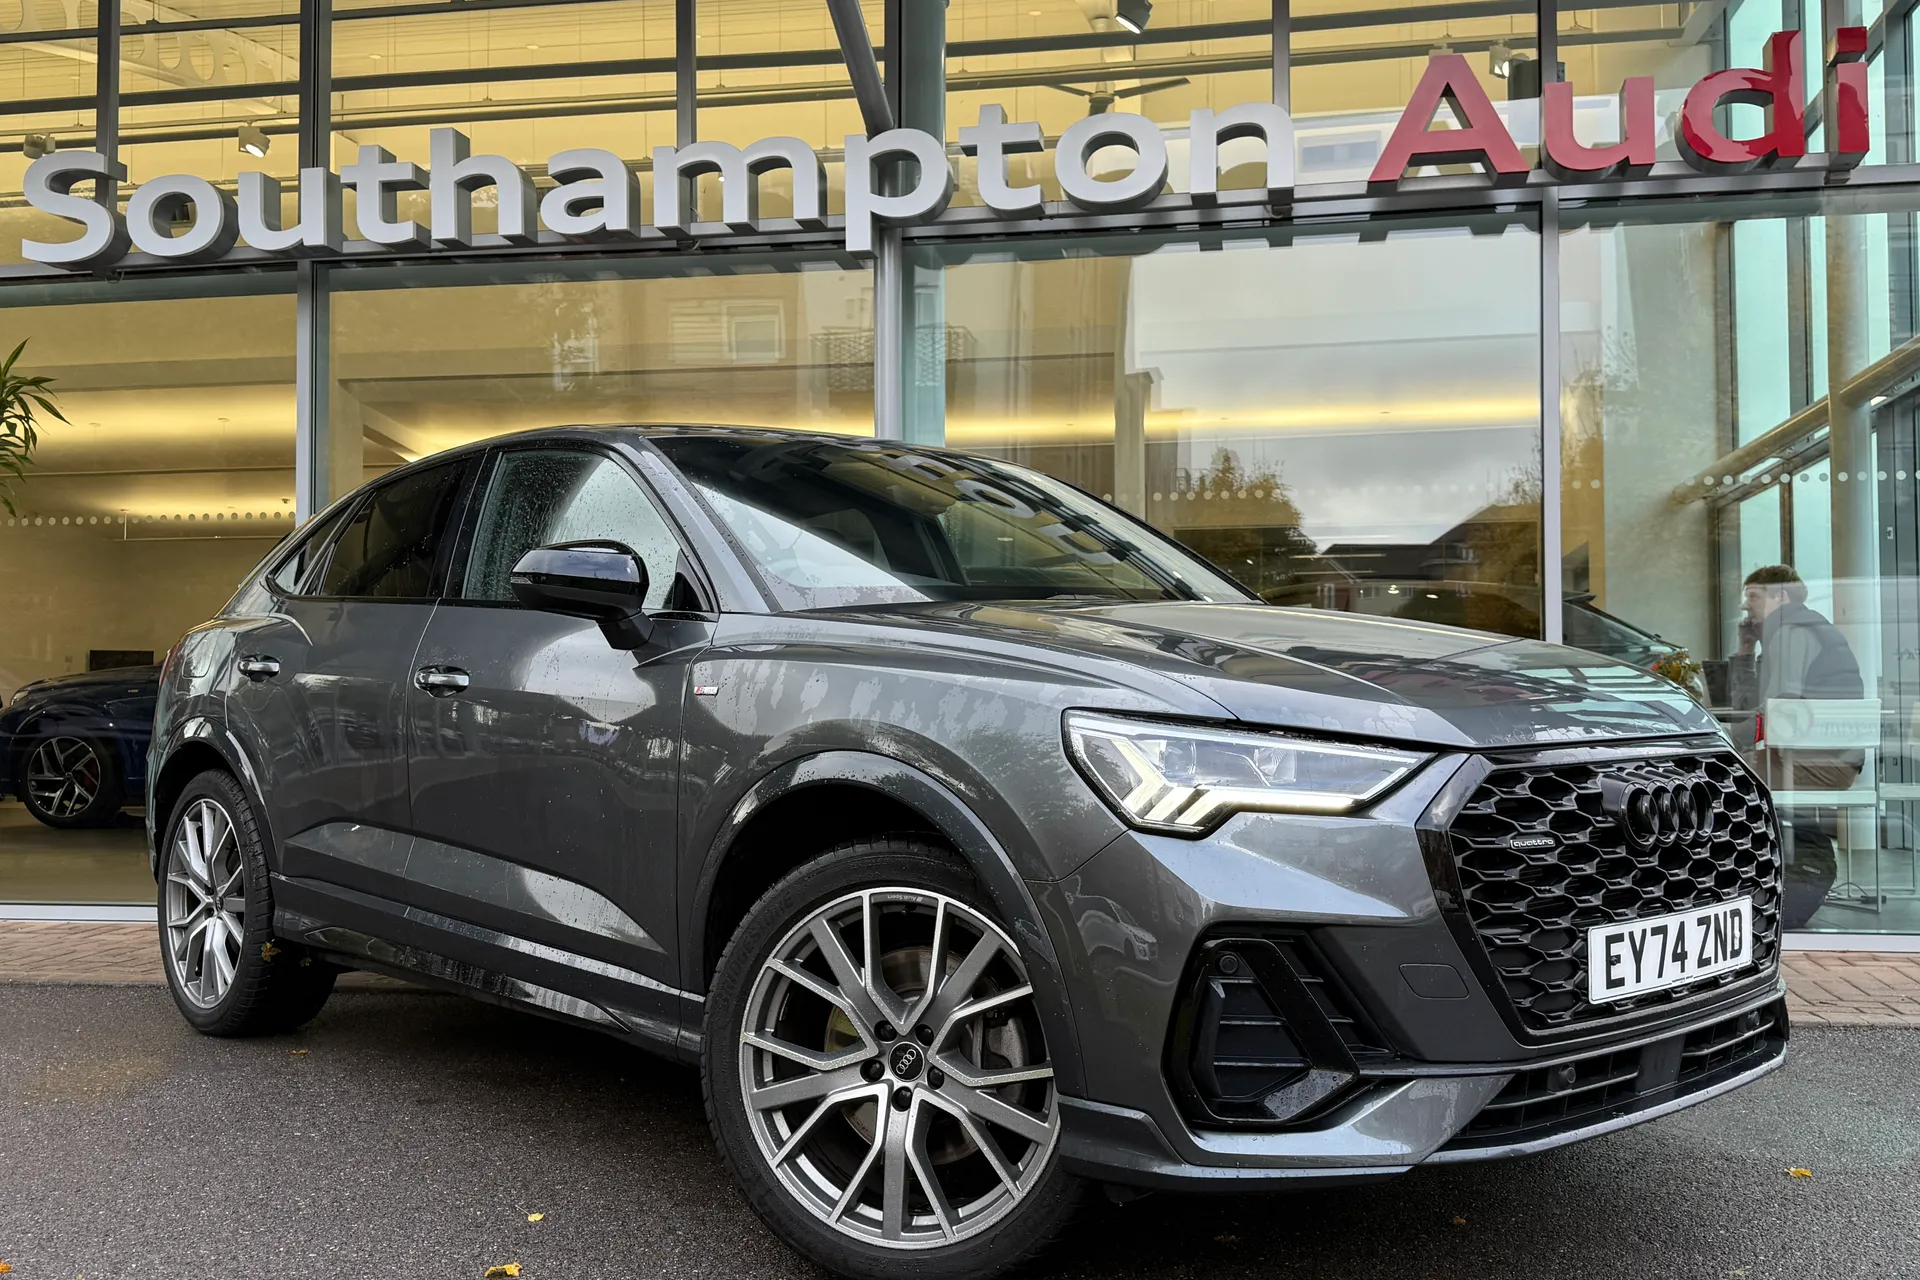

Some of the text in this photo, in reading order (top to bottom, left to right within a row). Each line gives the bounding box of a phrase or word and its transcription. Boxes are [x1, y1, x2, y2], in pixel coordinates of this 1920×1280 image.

[21, 26, 1870, 267] Southampton Audi
[1513, 839, 1554, 848] quattro
[1605, 908, 1743, 990] EY74 ZND
